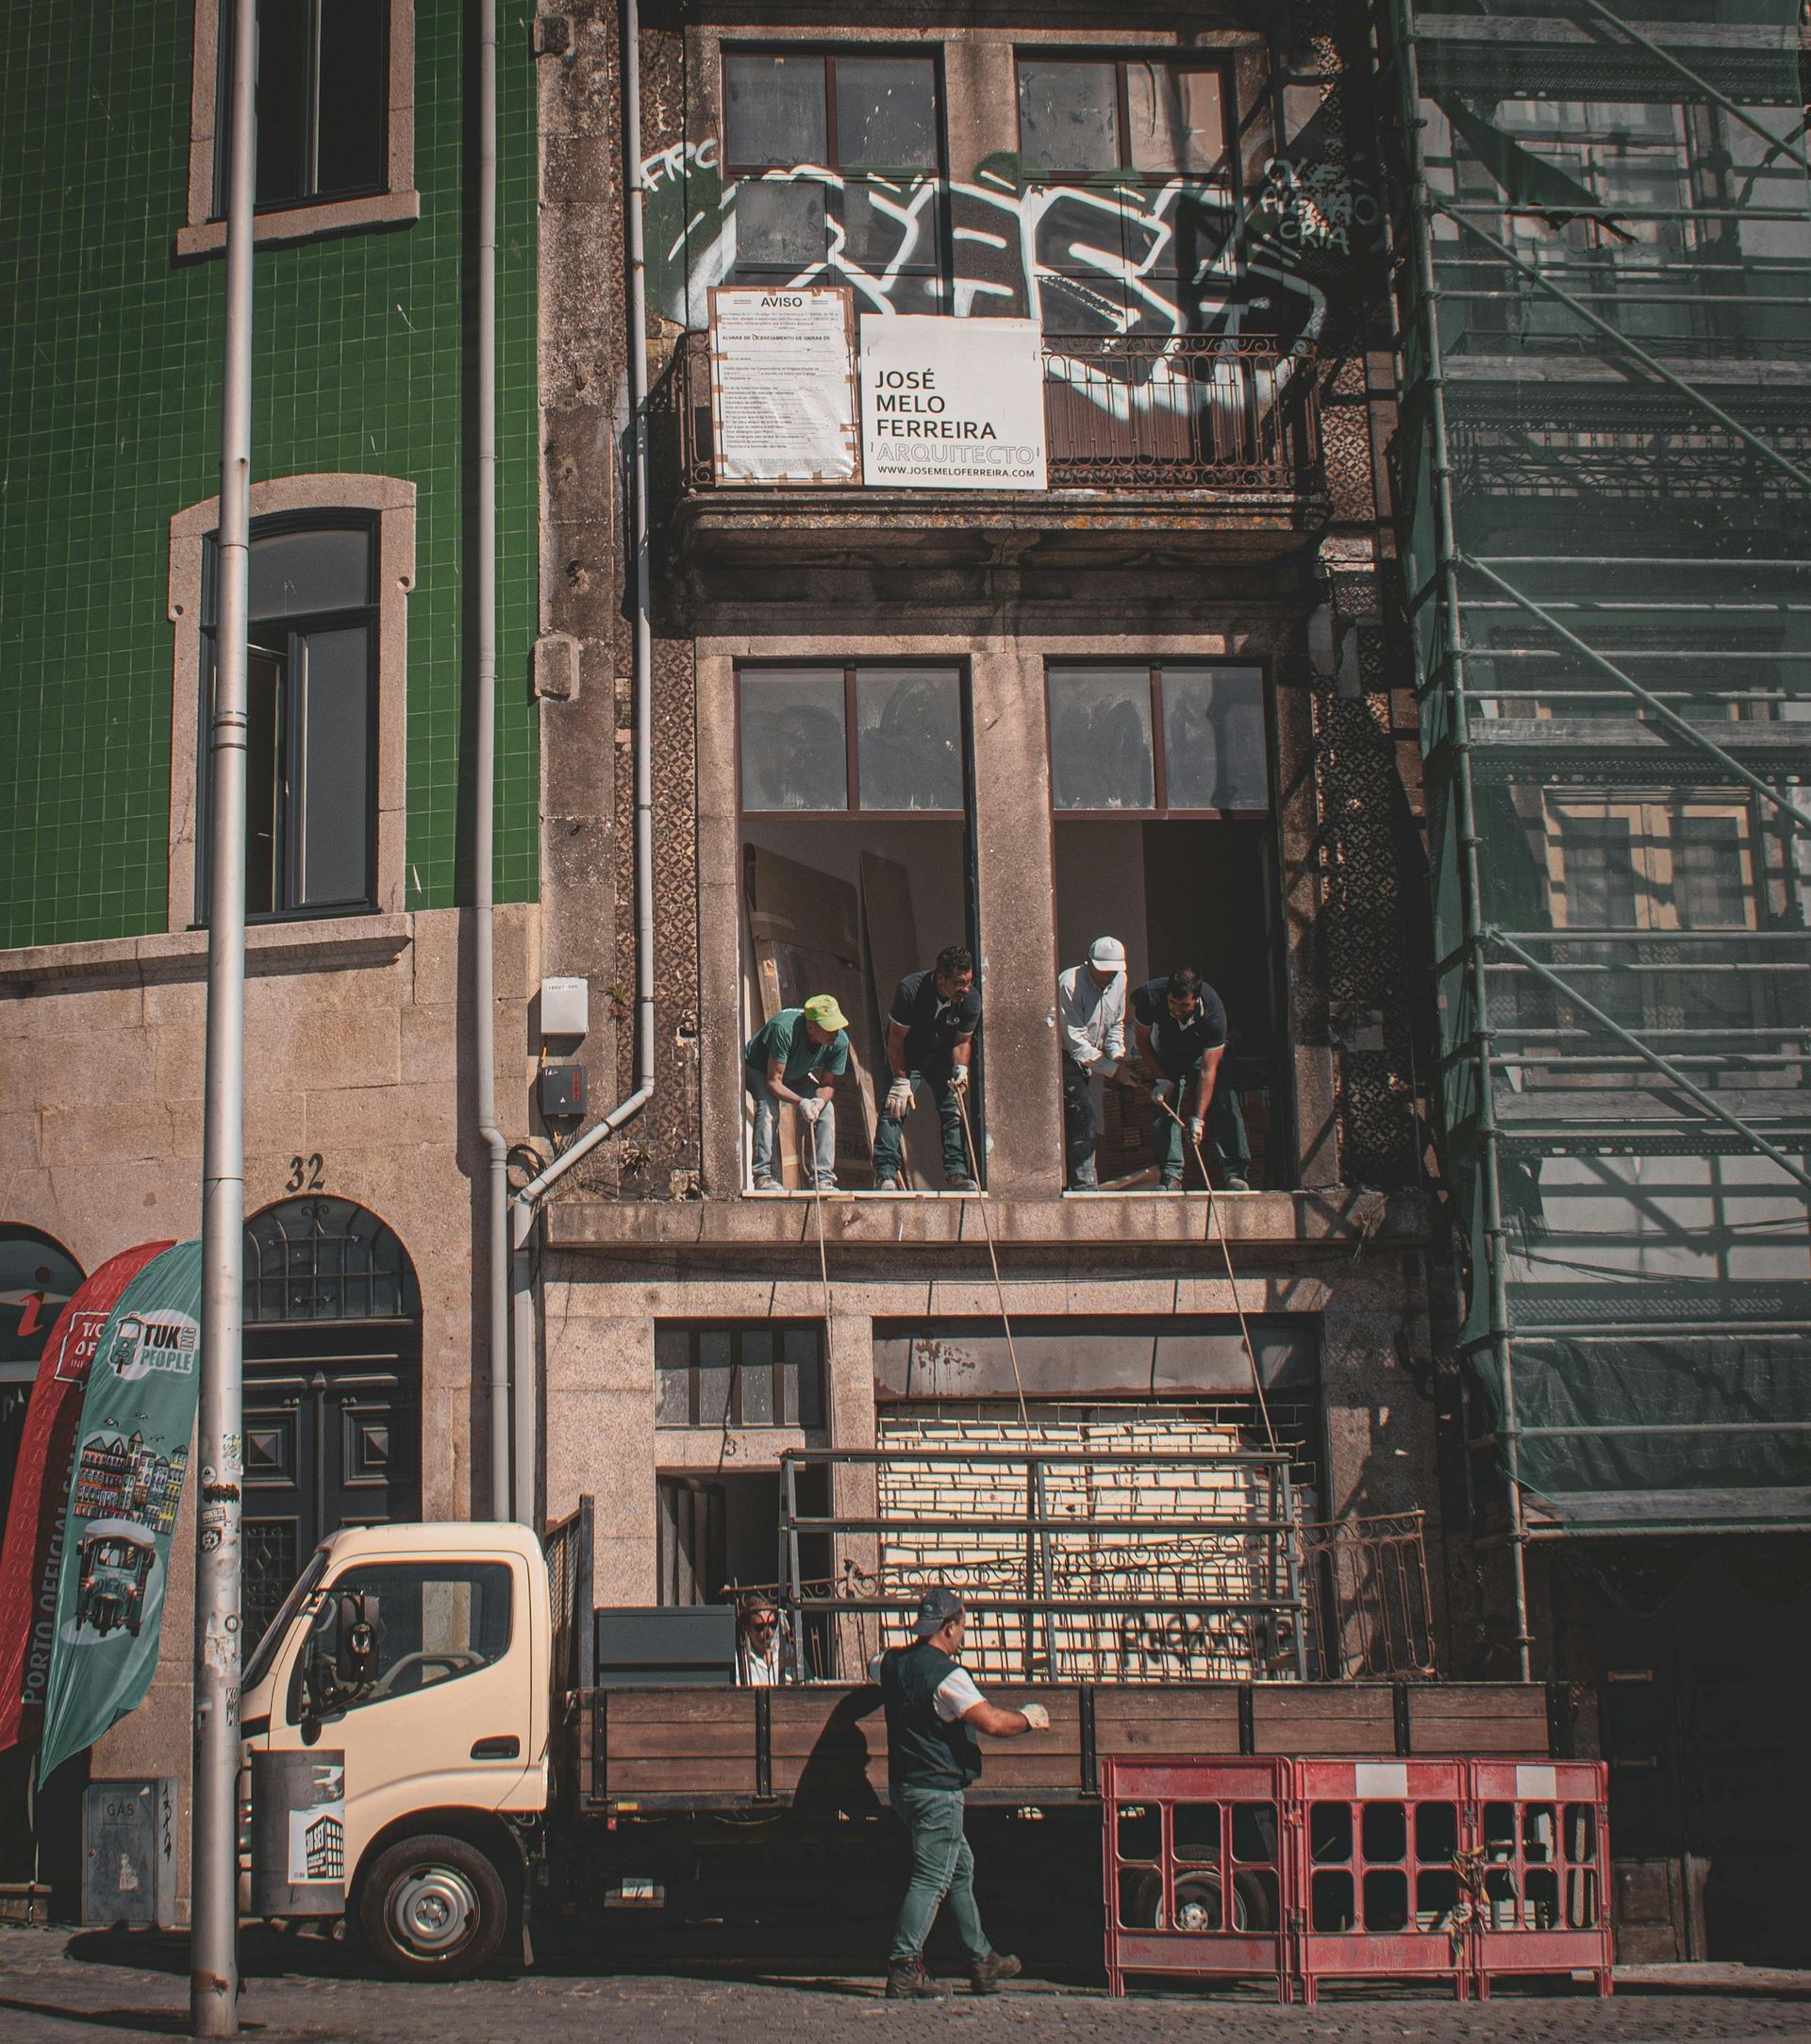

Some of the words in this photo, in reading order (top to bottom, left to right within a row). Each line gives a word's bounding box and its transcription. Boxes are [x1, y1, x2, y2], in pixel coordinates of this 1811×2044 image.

[760, 297, 803, 307] AVISO
[874, 368, 936, 390] JOSÉ
[876, 394, 946, 413] MELO
[876, 419, 997, 440] FERREIRA
[876, 442, 1035, 465] ARQUITECTO
[877, 465, 1035, 478] WWW.JOSEMELOFERREIRA.COM
[285, 1153, 325, 1193] 32
[143, 1323, 181, 1349] TUK
[139, 1347, 192, 1371] PEOPLE
